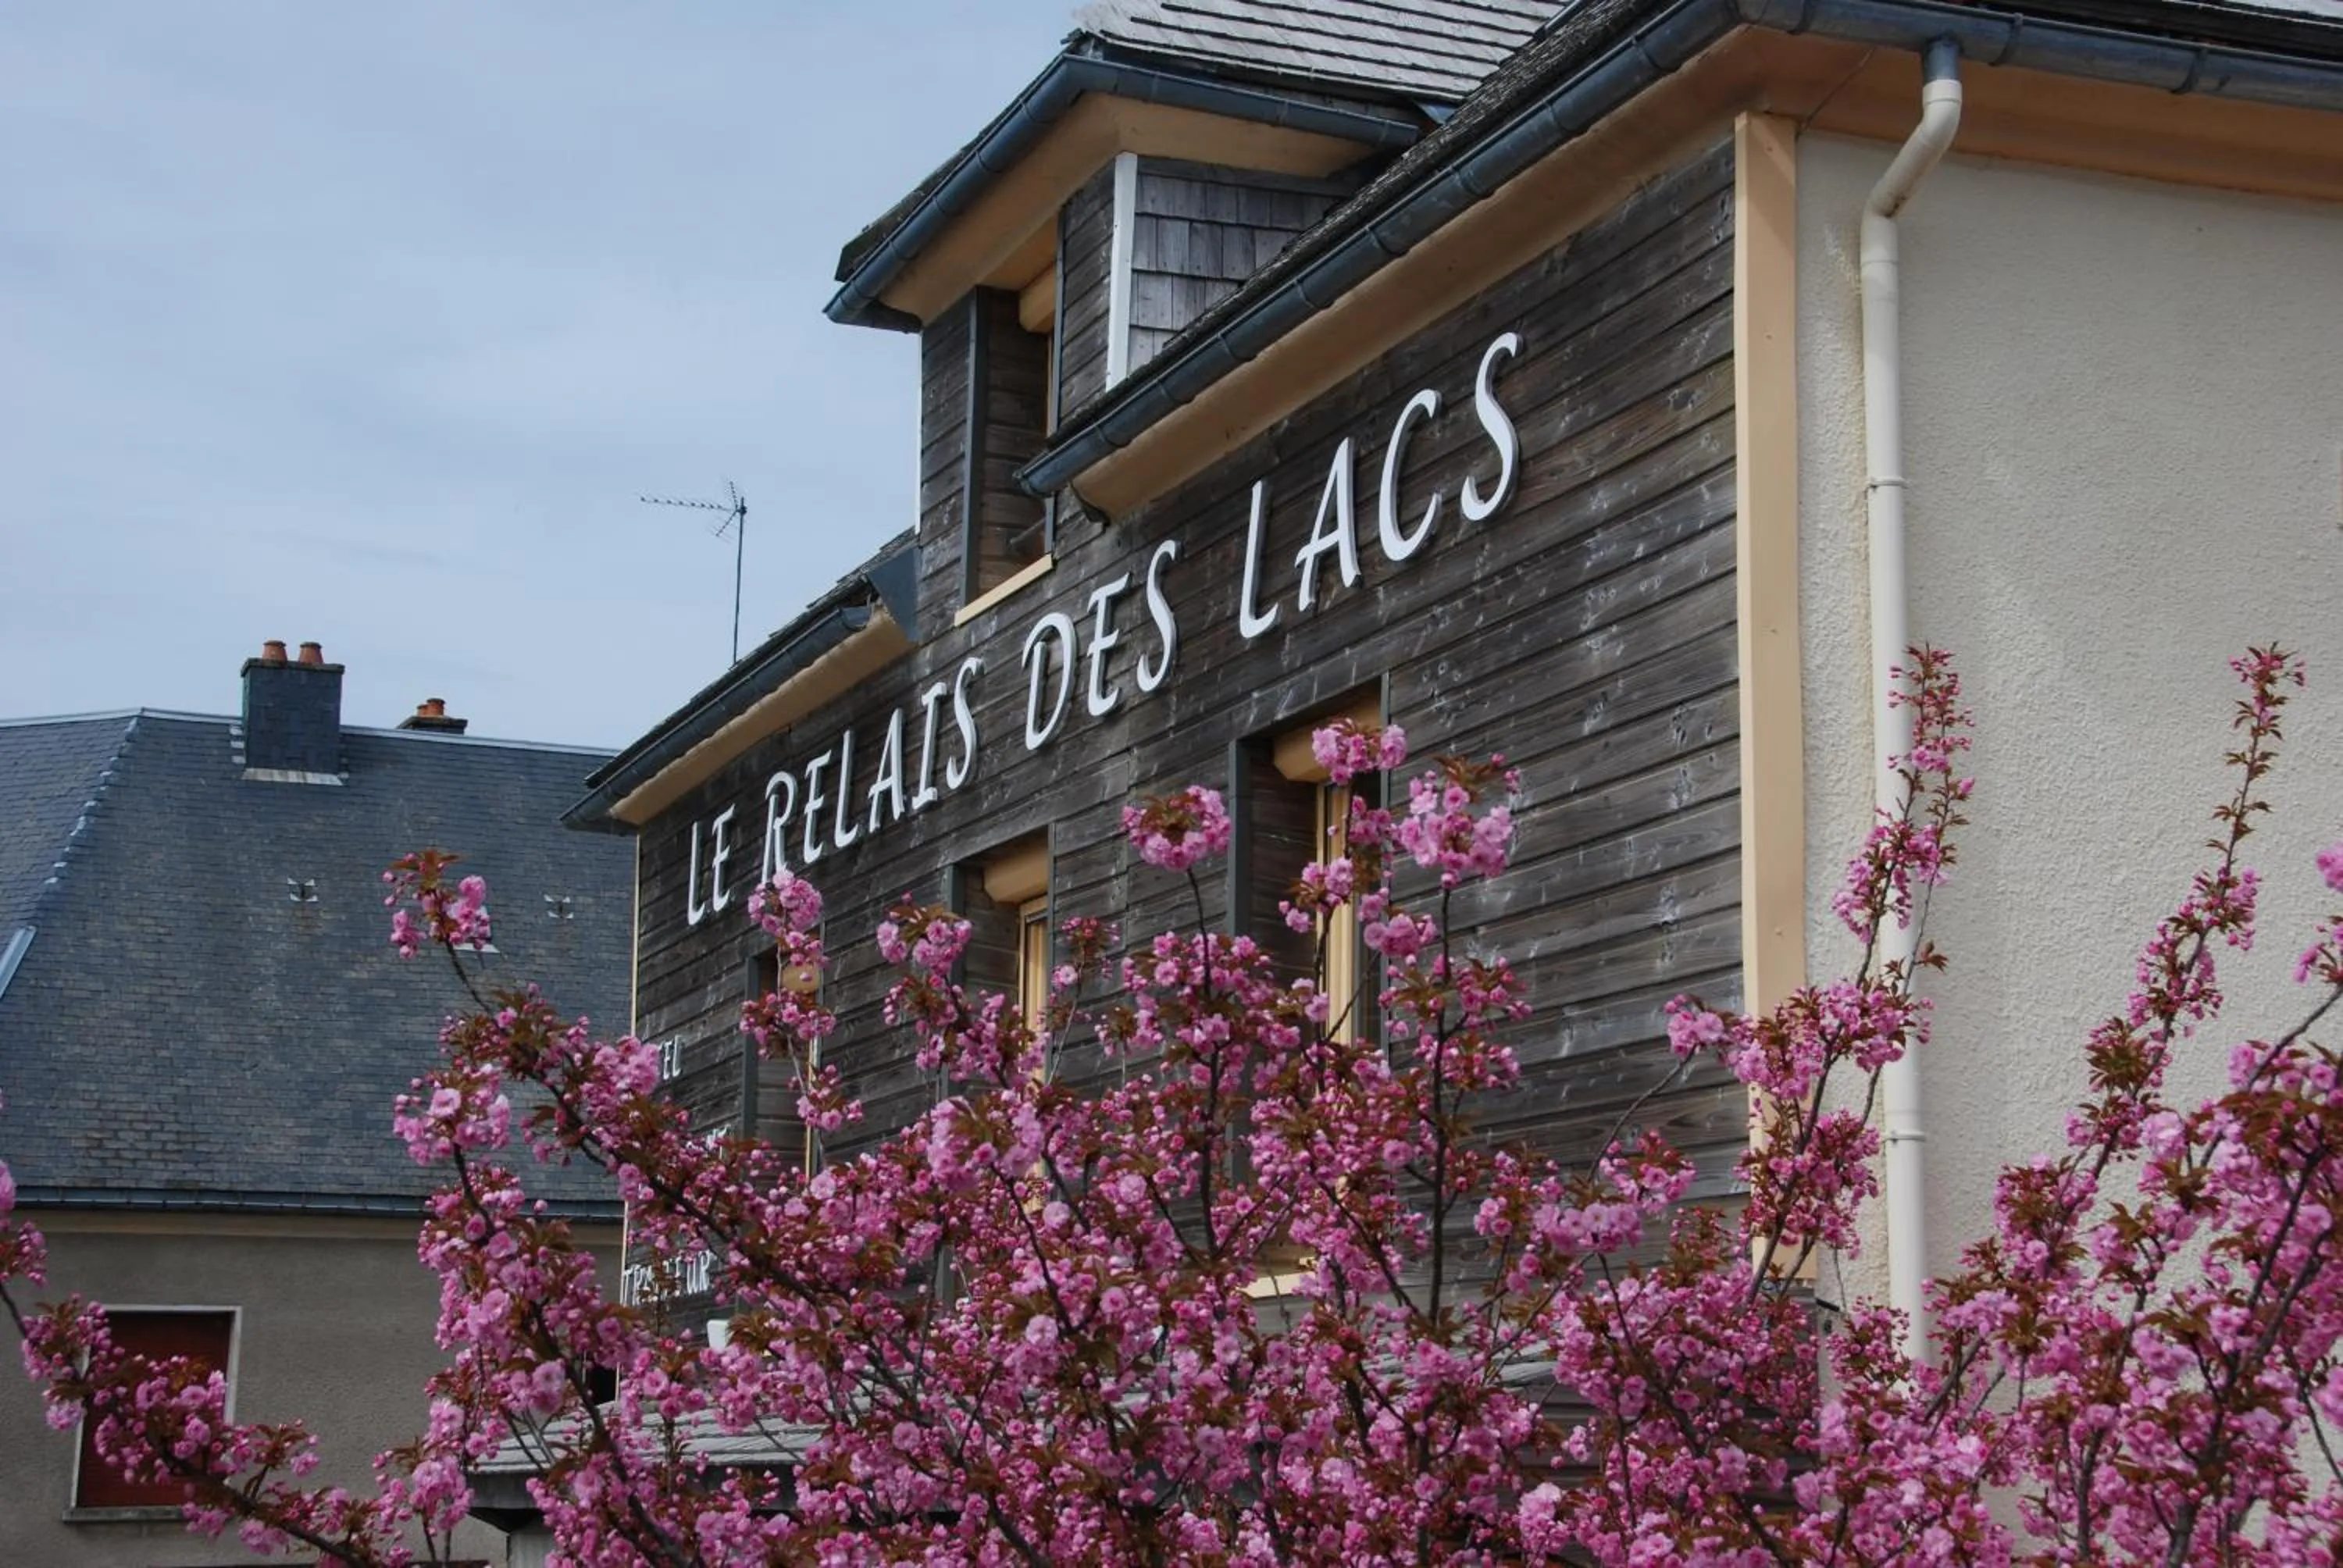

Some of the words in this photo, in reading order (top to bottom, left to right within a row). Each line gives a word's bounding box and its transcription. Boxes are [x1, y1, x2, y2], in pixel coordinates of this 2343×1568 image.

[687, 804, 735, 925] LE
[761, 657, 984, 885] RELAIS
[1022, 540, 1179, 750] DES
[1239, 332, 1523, 639] LACS
